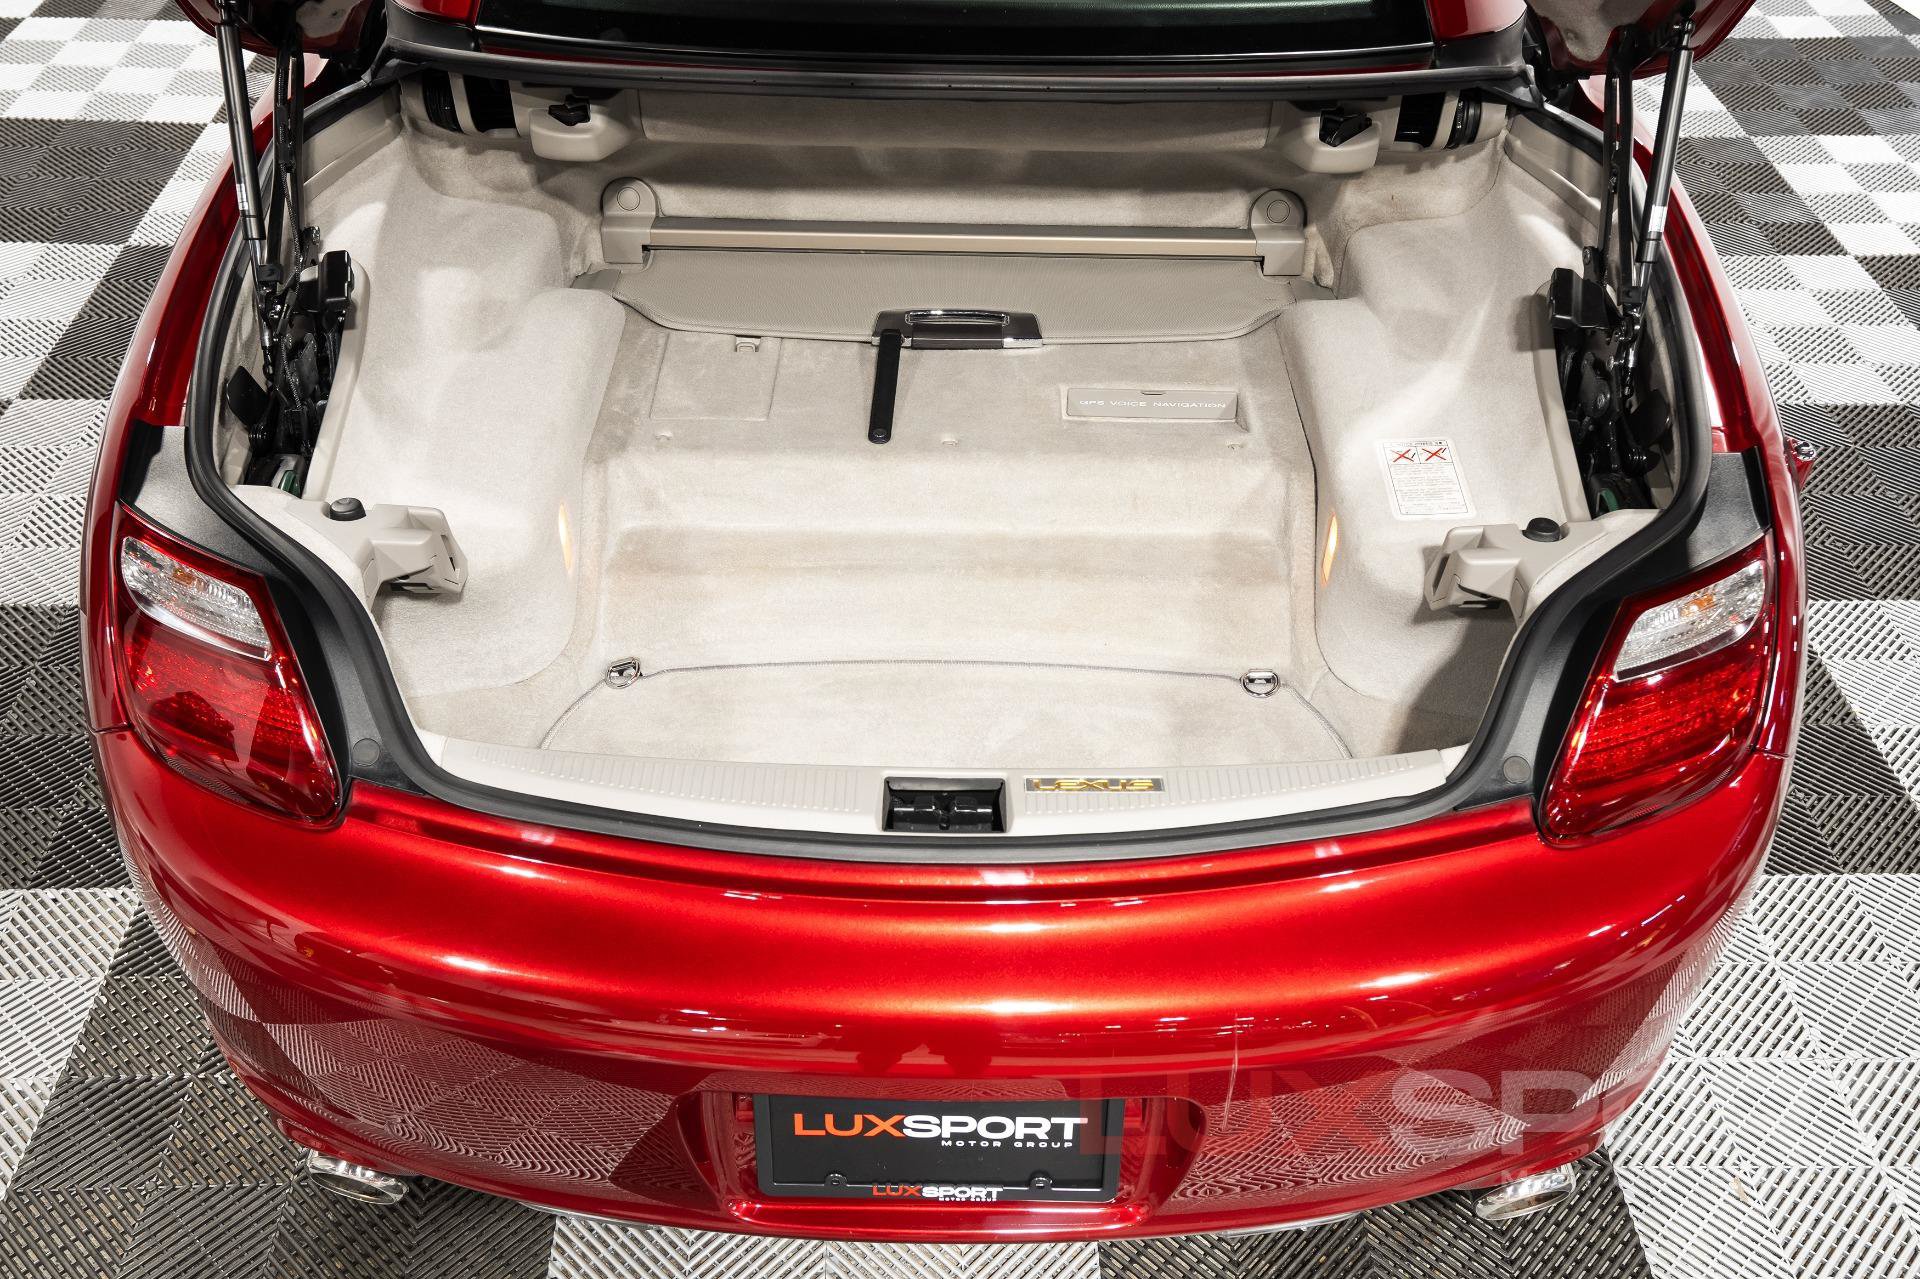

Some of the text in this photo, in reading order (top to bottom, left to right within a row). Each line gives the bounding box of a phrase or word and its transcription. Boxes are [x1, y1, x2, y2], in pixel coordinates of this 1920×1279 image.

[1032, 779, 1154, 792] LEXUS
[793, 1113, 1089, 1140] LUXSPORT
[872, 1184, 1004, 1199] LUXSPORT
